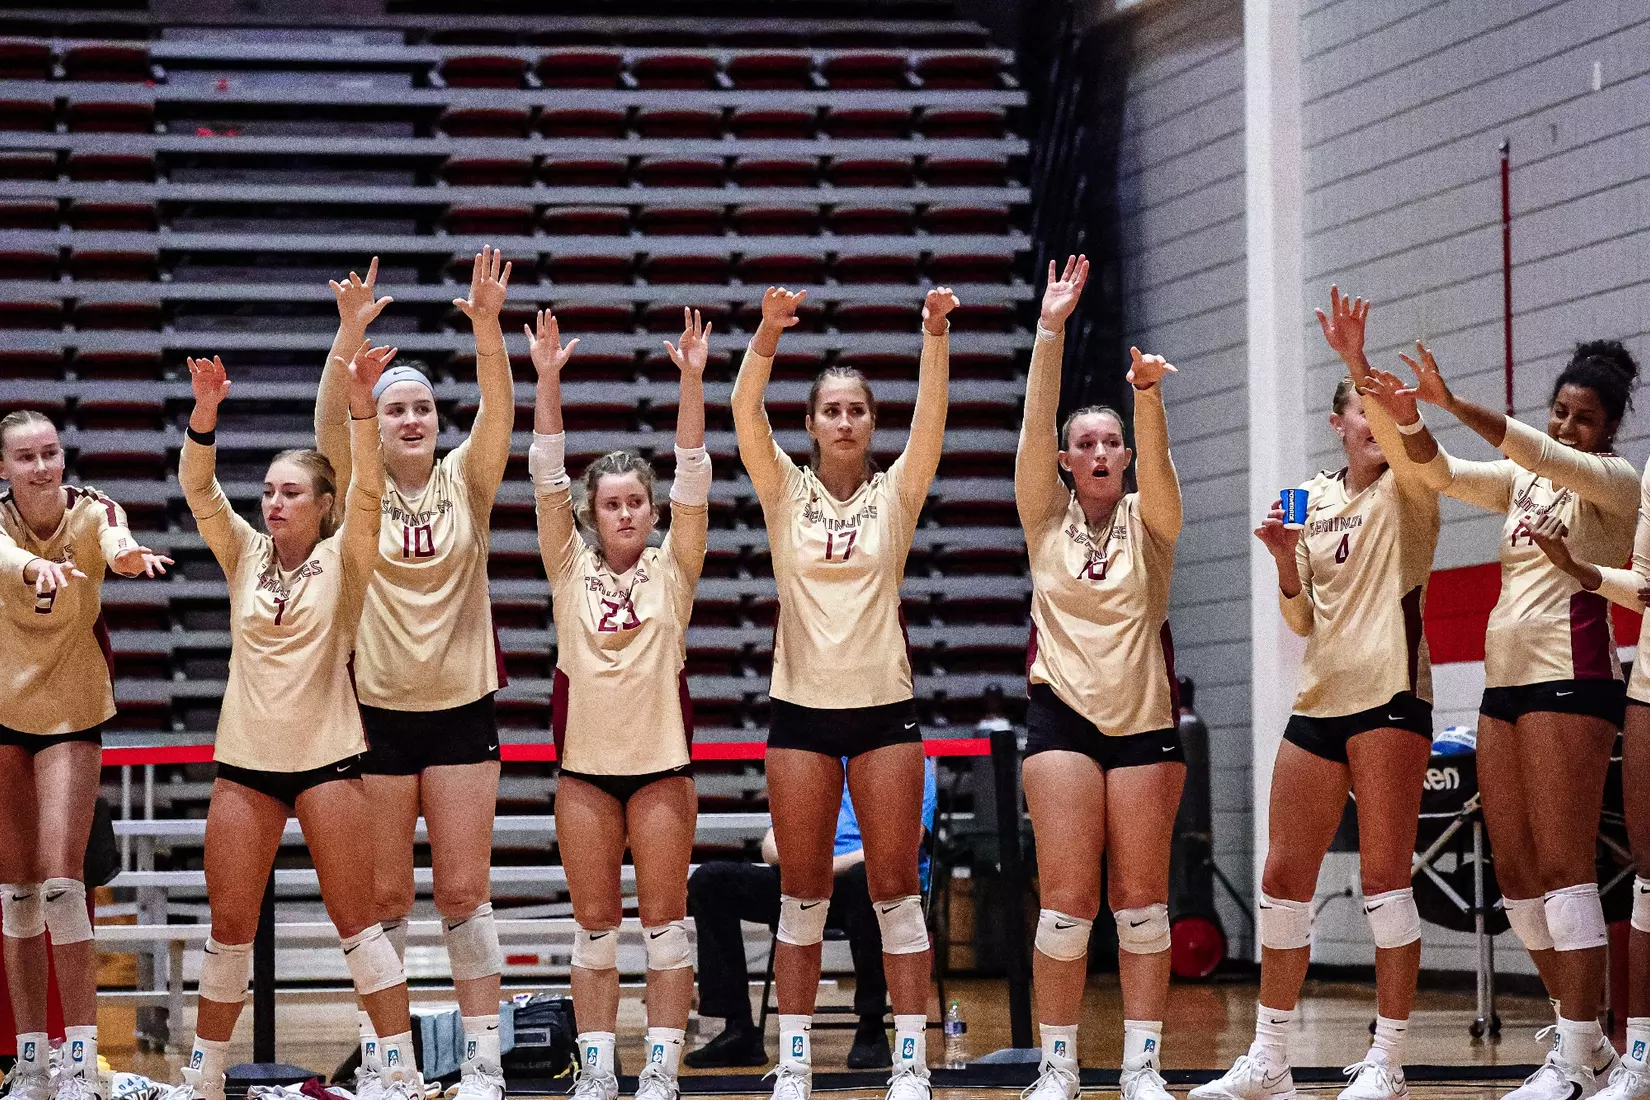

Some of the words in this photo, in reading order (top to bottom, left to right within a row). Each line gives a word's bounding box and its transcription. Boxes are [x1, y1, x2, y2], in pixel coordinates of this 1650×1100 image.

[403, 524, 436, 558] 10
[825, 530, 857, 560] 17
[1335, 533, 1350, 564] 4
